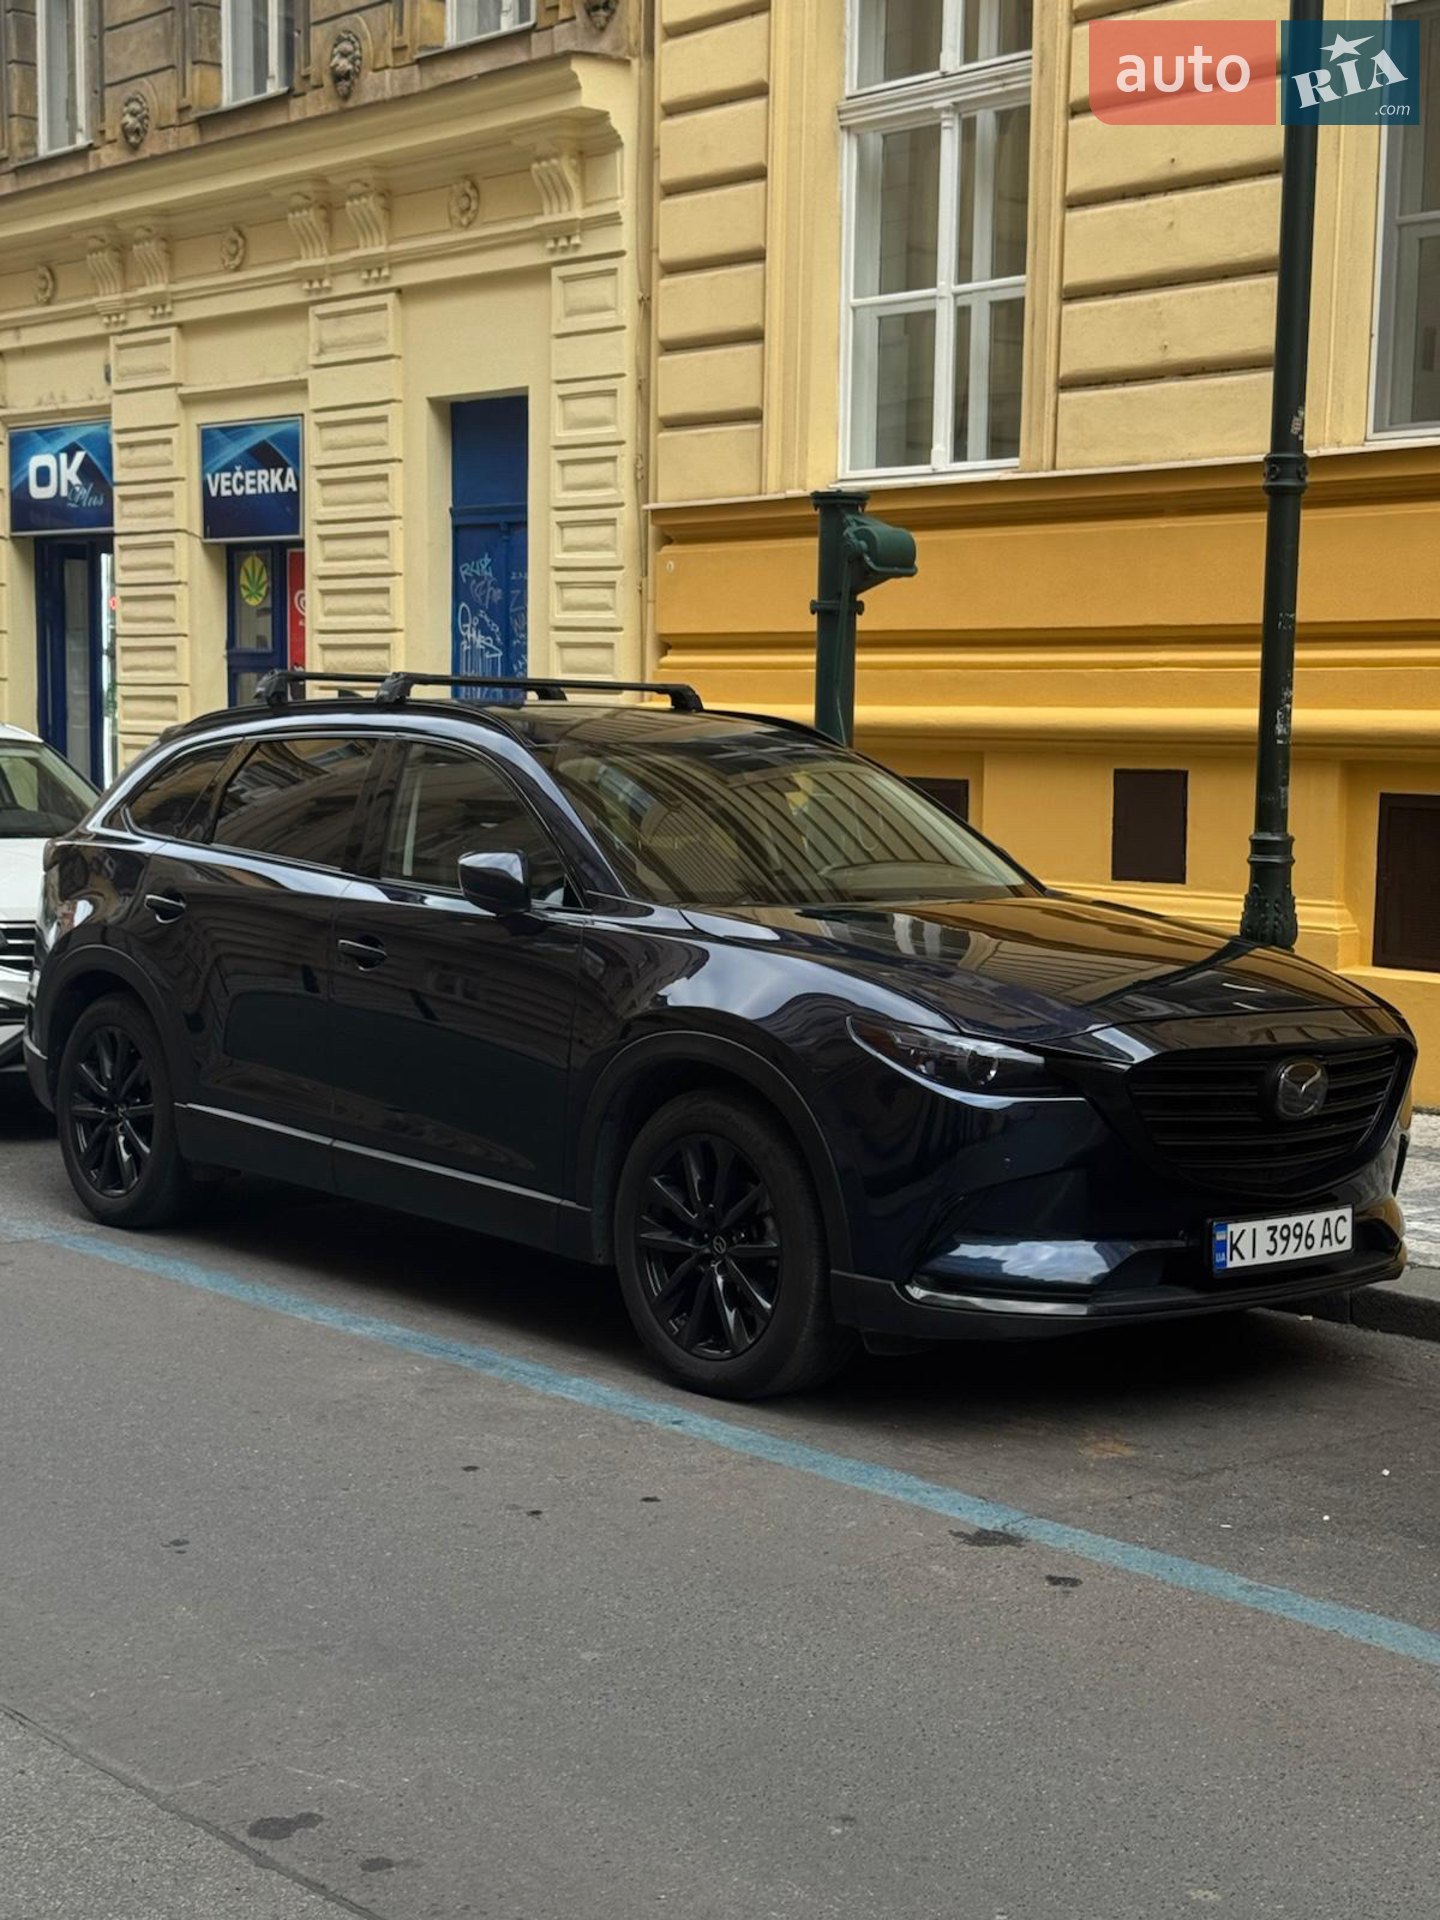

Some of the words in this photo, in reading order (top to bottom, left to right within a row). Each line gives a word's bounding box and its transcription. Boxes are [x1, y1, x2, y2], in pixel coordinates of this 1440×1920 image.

[28, 450, 87, 499] OK
[207, 465, 298, 498] VEČERKA
[67, 482, 105, 508] Plus
[1229, 1227, 1257, 1262] KI
[1266, 1219, 1315, 1257] 3996
[1320, 1215, 1348, 1249] AC
